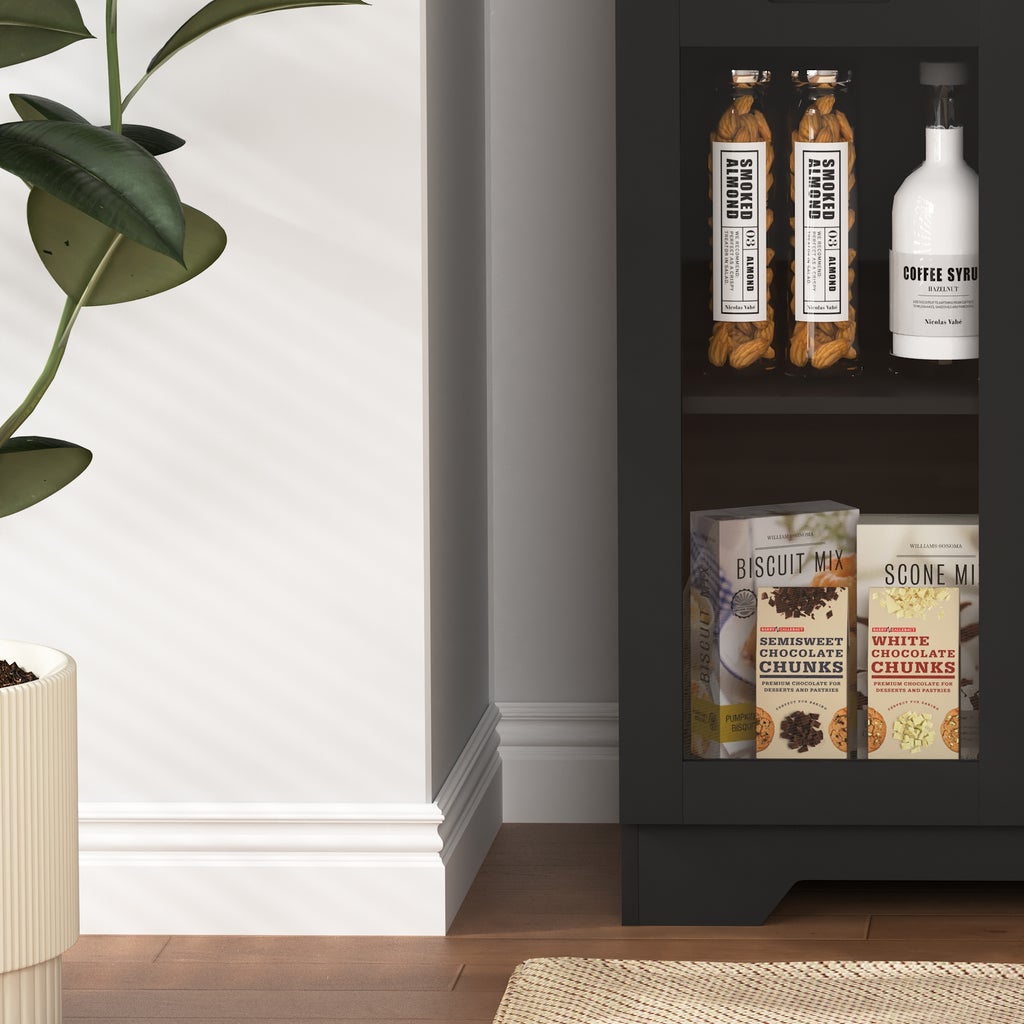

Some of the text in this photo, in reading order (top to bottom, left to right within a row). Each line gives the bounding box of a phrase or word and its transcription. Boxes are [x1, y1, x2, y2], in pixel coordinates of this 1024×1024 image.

[726, 158, 739, 219] ALMOND
[740, 159, 753, 220] SMOKED
[808, 158, 821, 219] ALMOND
[822, 159, 835, 220] SMOKED
[746, 230, 756, 247] 03
[828, 230, 838, 247] 03
[746, 256, 754, 292] ALMOND
[828, 256, 836, 292] ALMOND
[903, 266, 978, 281] COFFEE SYRU
[737, 549, 844, 580] BISCUIT MIX
[884, 563, 975, 586] SCONE MI
[699, 609, 711, 684] BISCUIT
[759, 637, 843, 646] SEMISWEET
[872, 636, 930, 646] WHITE
[759, 649, 843, 658] CHOCOLATE
[872, 649, 955, 658] CHOCOLATE
[759, 661, 843, 673] CHUNKS
[871, 661, 955, 674] CHUNKS
